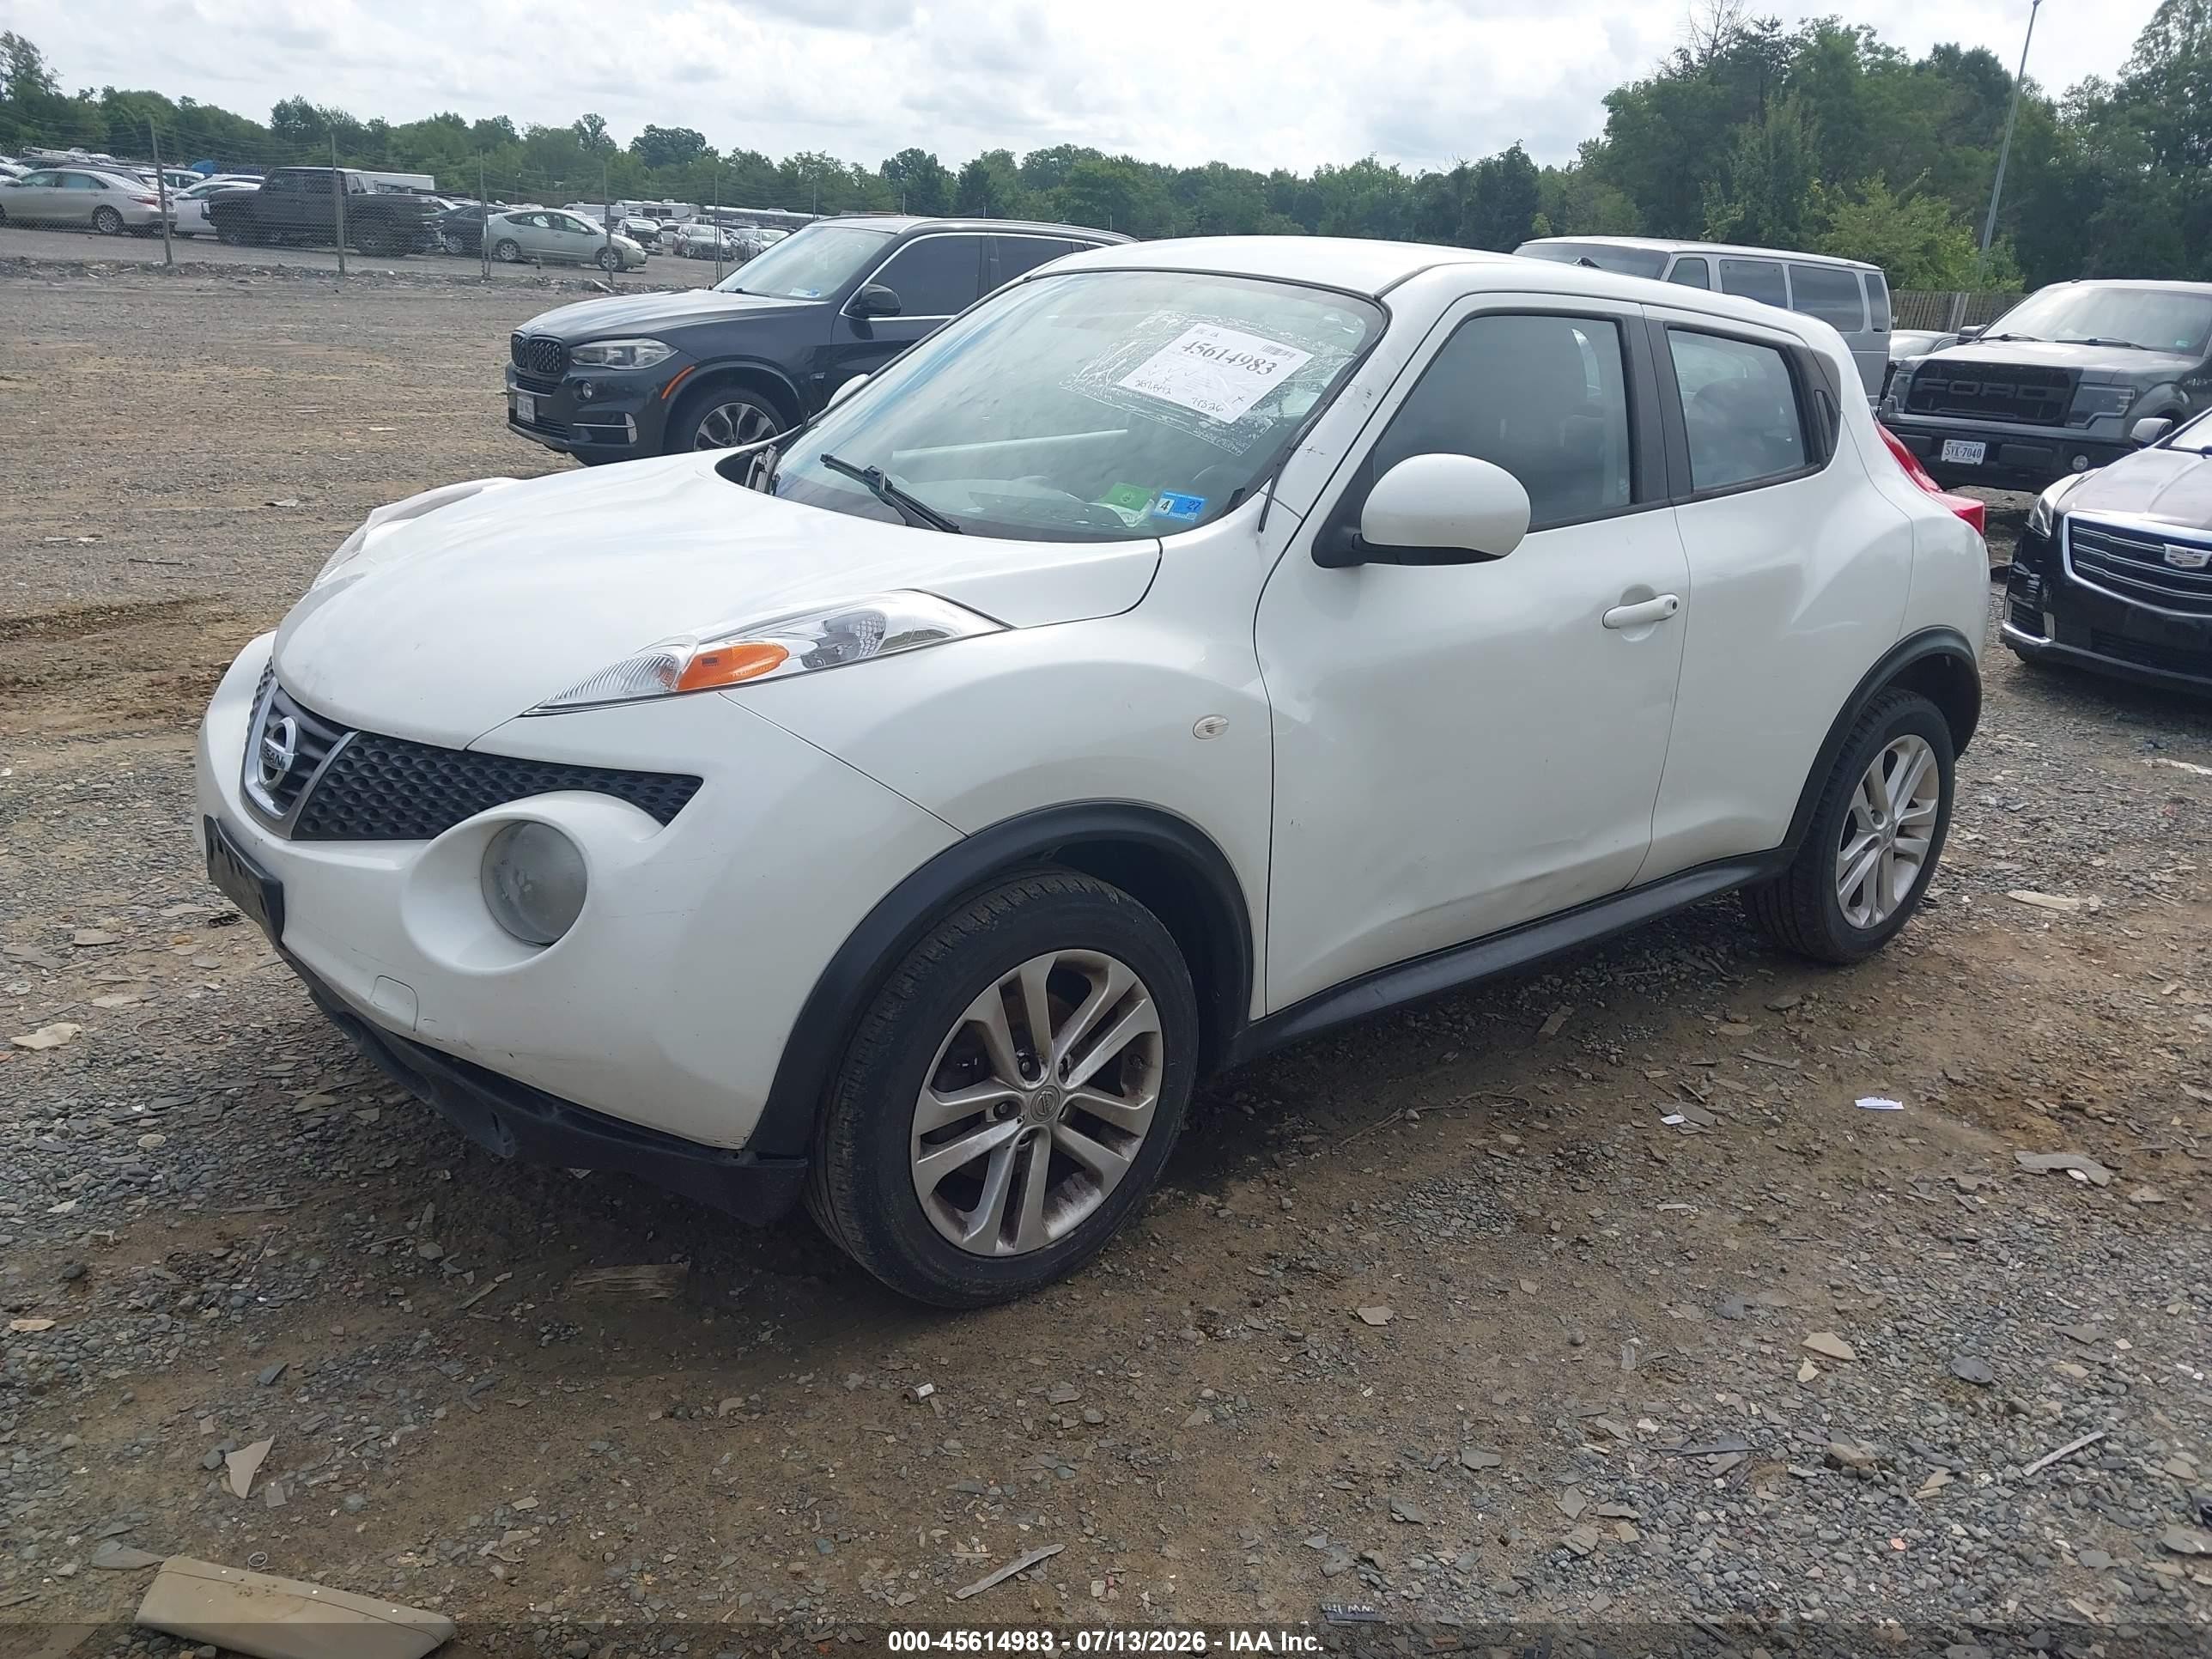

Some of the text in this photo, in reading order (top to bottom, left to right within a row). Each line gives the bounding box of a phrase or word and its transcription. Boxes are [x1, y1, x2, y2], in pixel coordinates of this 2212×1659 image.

[1182, 340, 1277, 375] 45614983
[1916, 377, 2061, 401] FORD
[1160, 500, 1201, 511] 4 27
